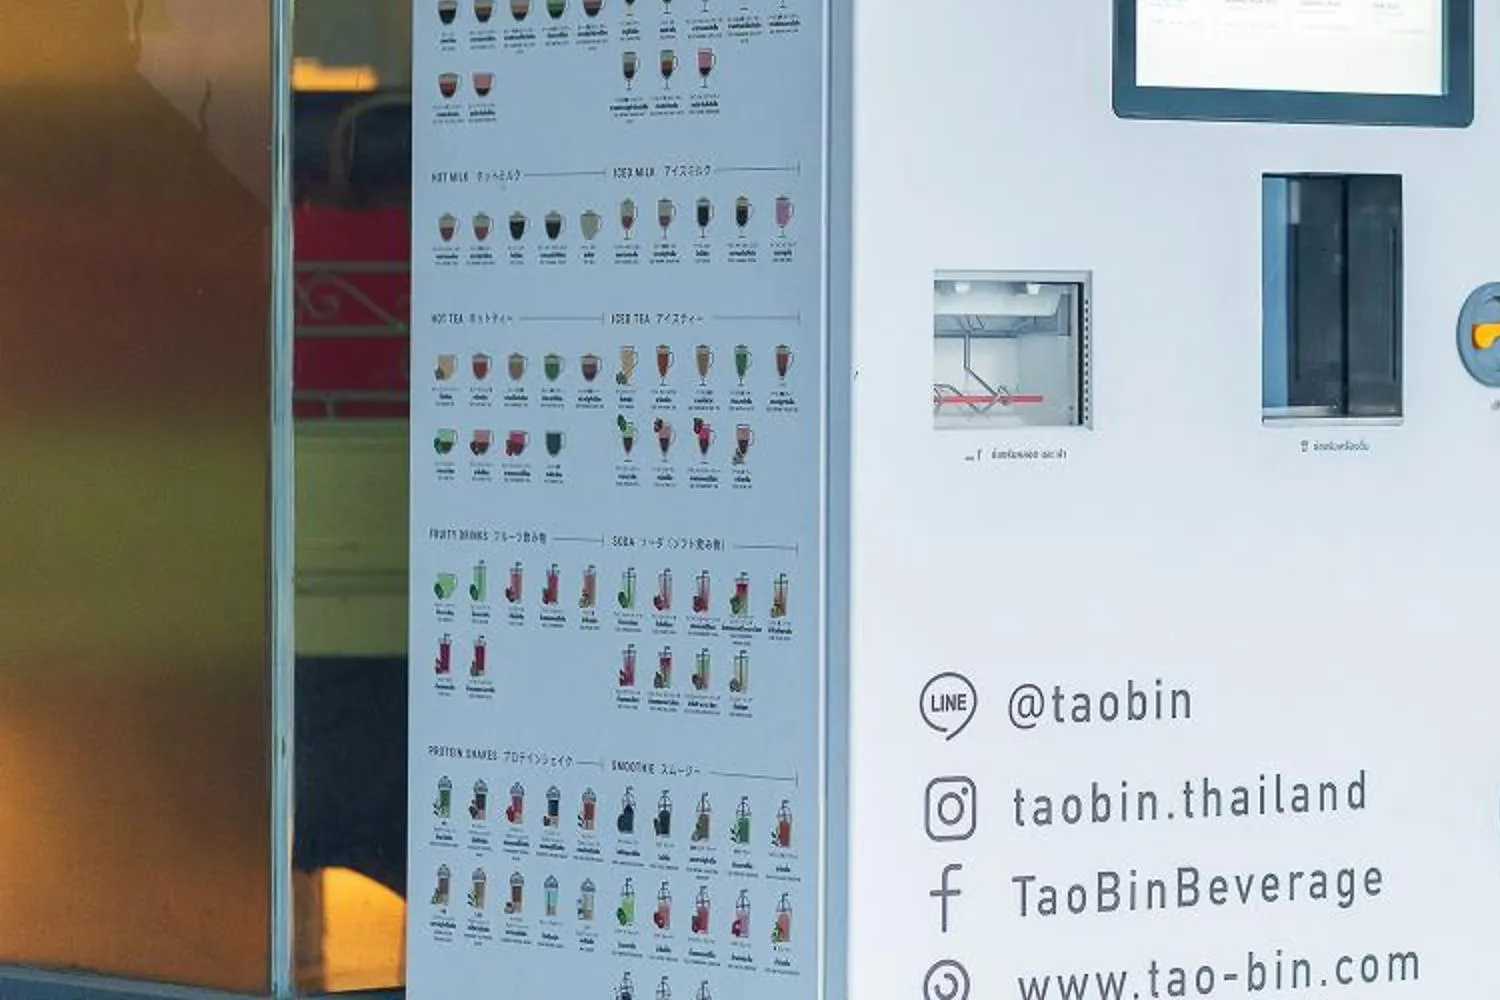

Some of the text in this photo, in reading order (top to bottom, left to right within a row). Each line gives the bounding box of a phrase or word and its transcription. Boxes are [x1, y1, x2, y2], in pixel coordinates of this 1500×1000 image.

[634, 312, 651, 325] TEA
[459, 528, 489, 542] DRINKS
[930, 693, 968, 713] LINE
[1008, 679, 1193, 730] @taobin
[1013, 769, 1367, 828] taobin.thailand
[1011, 863, 1385, 918] TaoBinBeverage
[1017, 948, 1421, 1000] www.tao-bin.com
